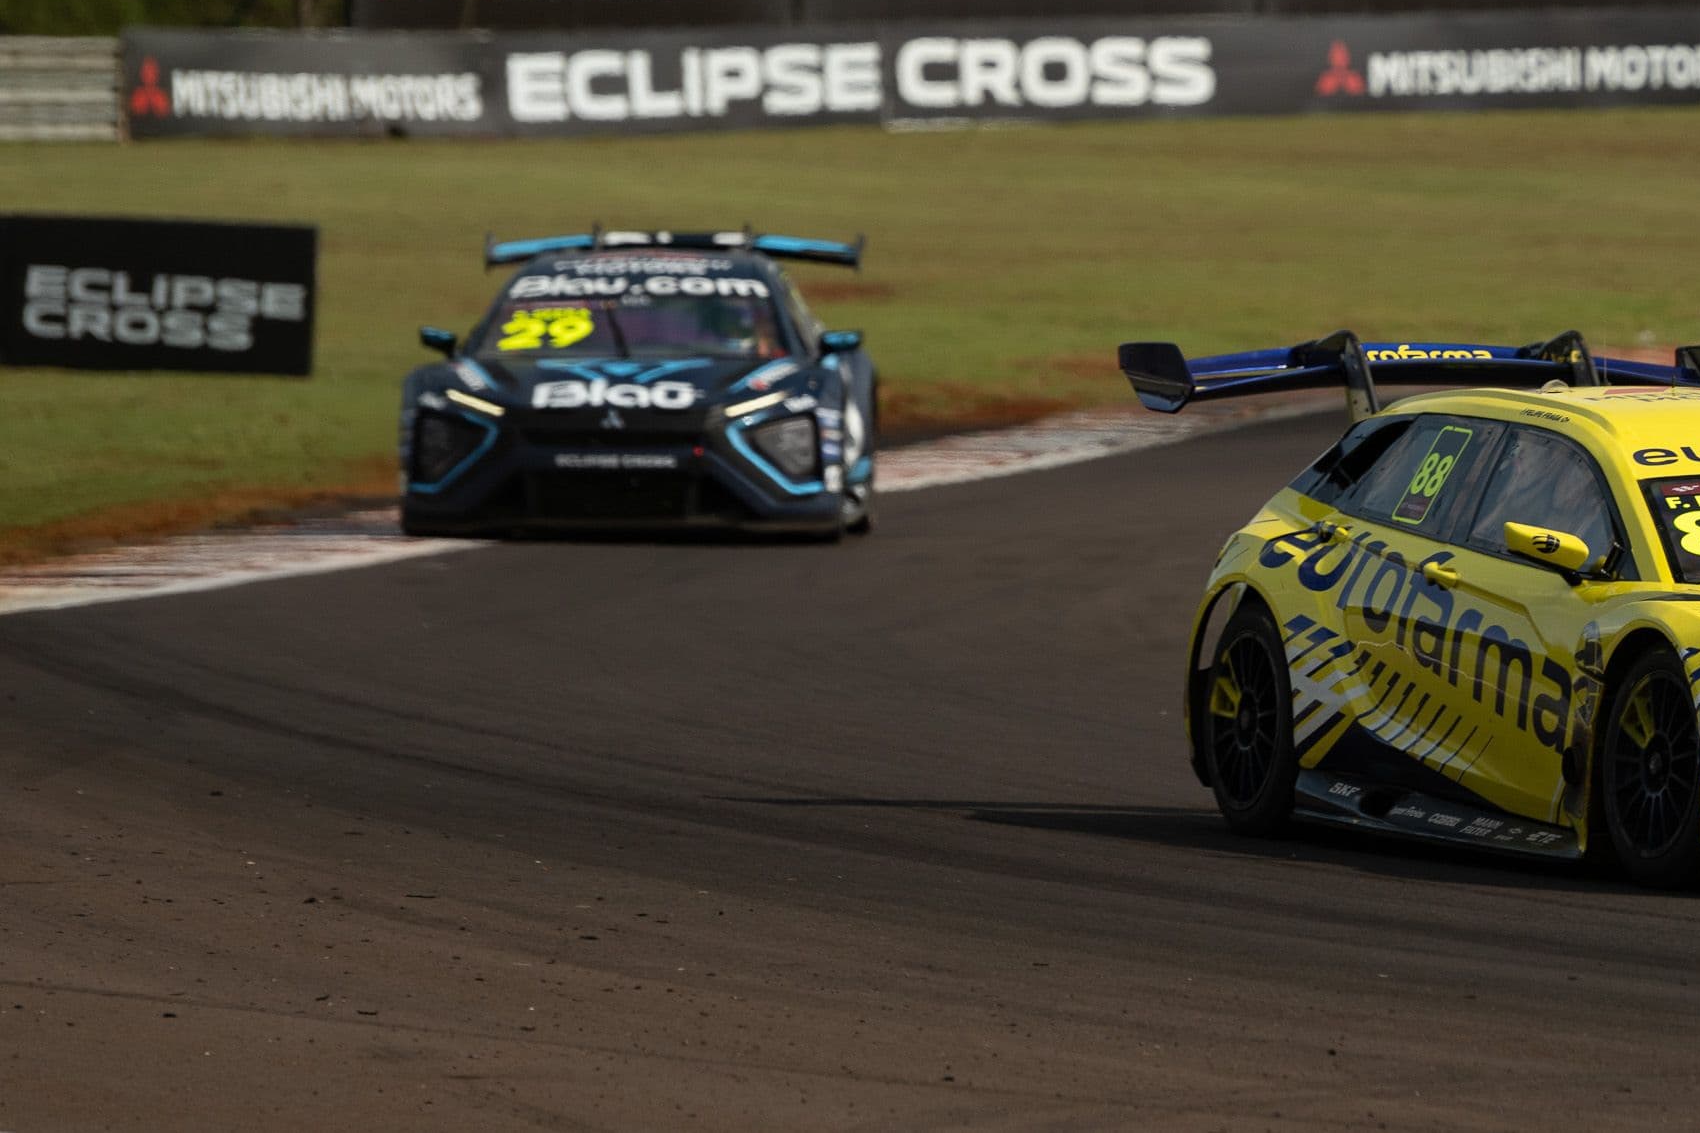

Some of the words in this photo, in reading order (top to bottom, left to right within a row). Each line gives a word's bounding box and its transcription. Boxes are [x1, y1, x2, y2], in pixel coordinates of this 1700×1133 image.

[171, 68, 348, 120] MITSUBISHI
[349, 72, 484, 122] MOTORS
[506, 42, 882, 123] ECLIPSE
[896, 35, 1217, 108] CROSS
[1367, 47, 1581, 98] MITSUBISHI
[23, 265, 306, 322] ECLIPSE
[21, 301, 254, 352] CROSS
[496, 318, 595, 352] 29
[1410, 452, 1454, 498] 88
[1665, 496, 1692, 510] F.
[1258, 525, 1574, 756] eurofarma
